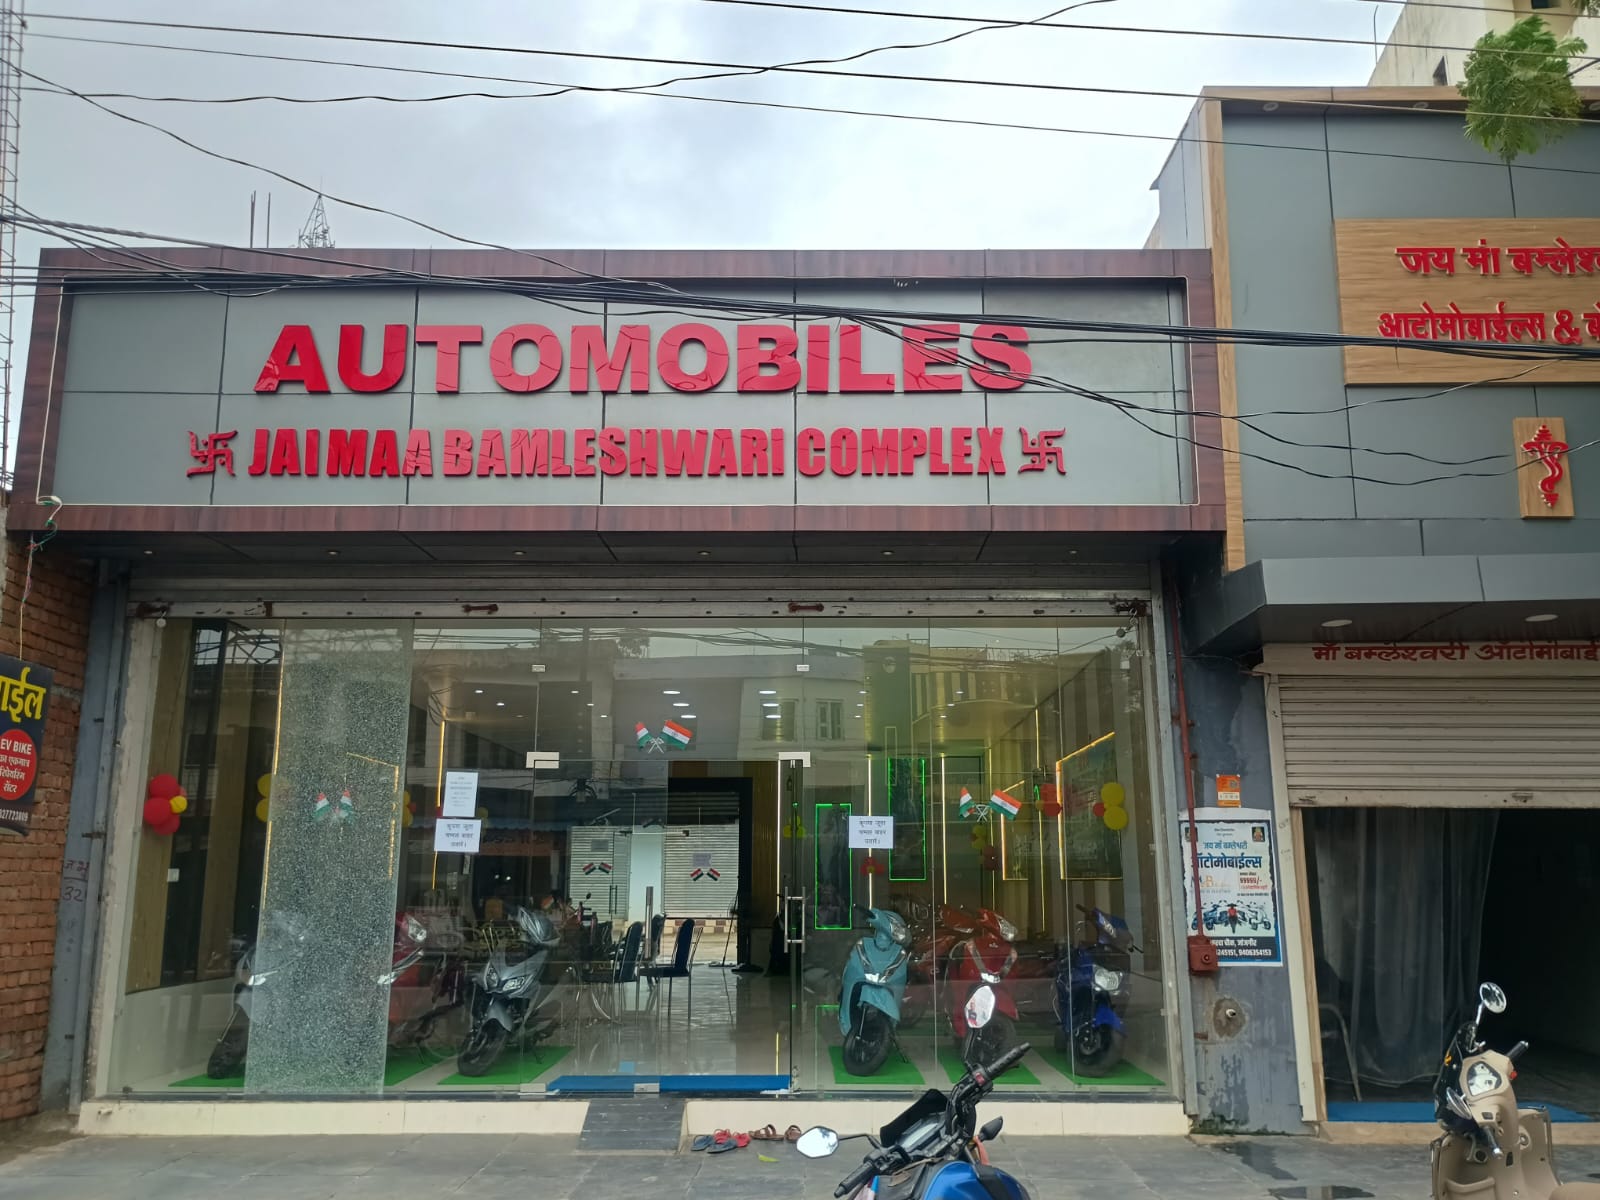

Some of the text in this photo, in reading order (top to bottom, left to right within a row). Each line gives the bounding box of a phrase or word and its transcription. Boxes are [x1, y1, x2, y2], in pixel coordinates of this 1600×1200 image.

[1395, 247, 1456, 276] जय
[1460, 238, 1501, 276] मां
[1377, 301, 1547, 344] आटोमोबाईल्स
[1552, 309, 1584, 345] &
[254, 323, 1032, 395] AUTOMOBILES
[248, 426, 1007, 477] JAI MAA BAMLESHWARI COMPLEX
[0, 738, 33, 755] EV BIKE
